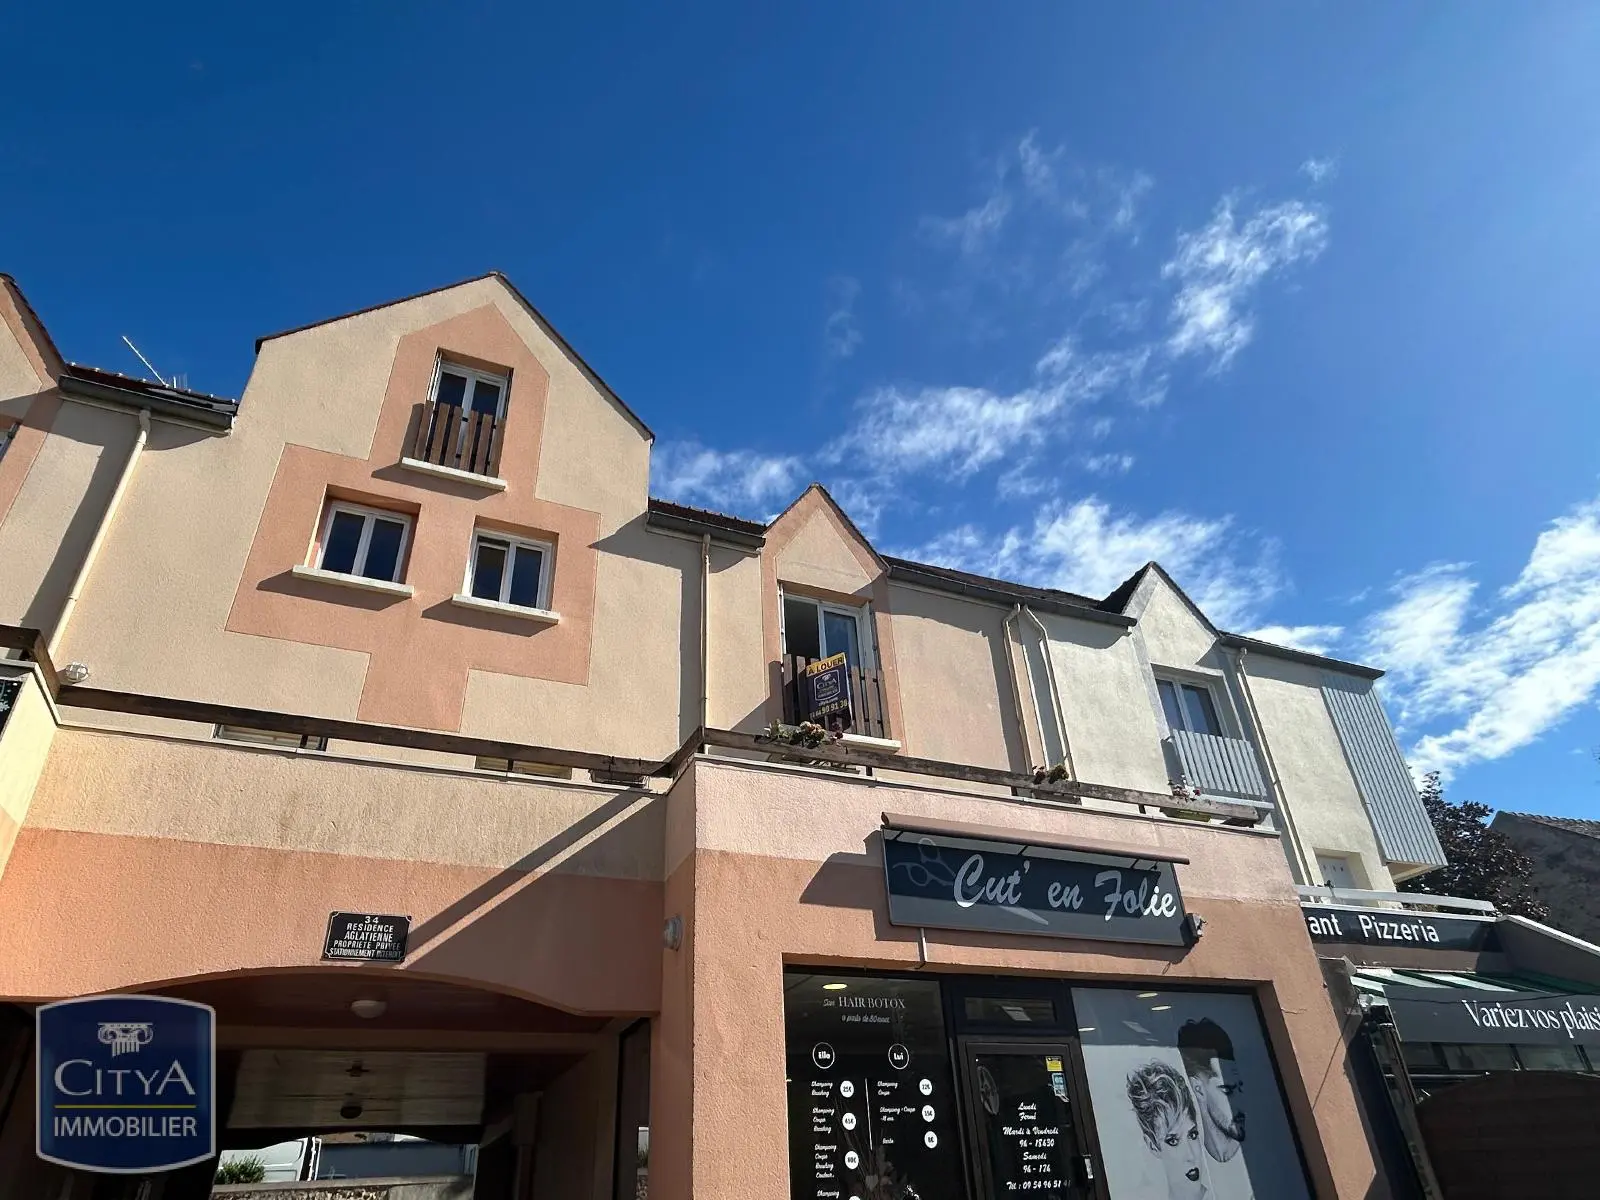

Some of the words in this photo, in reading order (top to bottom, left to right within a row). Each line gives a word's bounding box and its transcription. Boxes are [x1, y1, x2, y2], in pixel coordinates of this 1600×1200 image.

[816, 657, 843, 671] LOUER
[831, 702, 839, 711] 91
[953, 854, 1031, 908] Cut'
[1047, 880, 1084, 910] en
[1095, 870, 1177, 921] Folie
[364, 916, 379, 924] 34
[346, 923, 394, 933] RESIDENCE
[1359, 914, 1440, 944] Pizzeria
[343, 931, 393, 943] AGLATIENNE
[329, 948, 375, 958] STATIONNEMENT
[838, 996, 866, 1008] HAIR
[868, 997, 906, 1009] BOTOX
[1462, 1000, 1528, 1029] Variez
[1528, 1008, 1560, 1030] vos
[893, 1052, 904, 1060] Lui
[1018, 1102, 1036, 1110] Lundi
[1002, 1126, 1024, 1135] Mardi
[1032, 1126, 1059, 1135] Vendredi
[1023, 1152, 1047, 1160] Samedi
[1022, 1181, 1032, 1190] 09
[1043, 1180, 1051, 1188] 96
